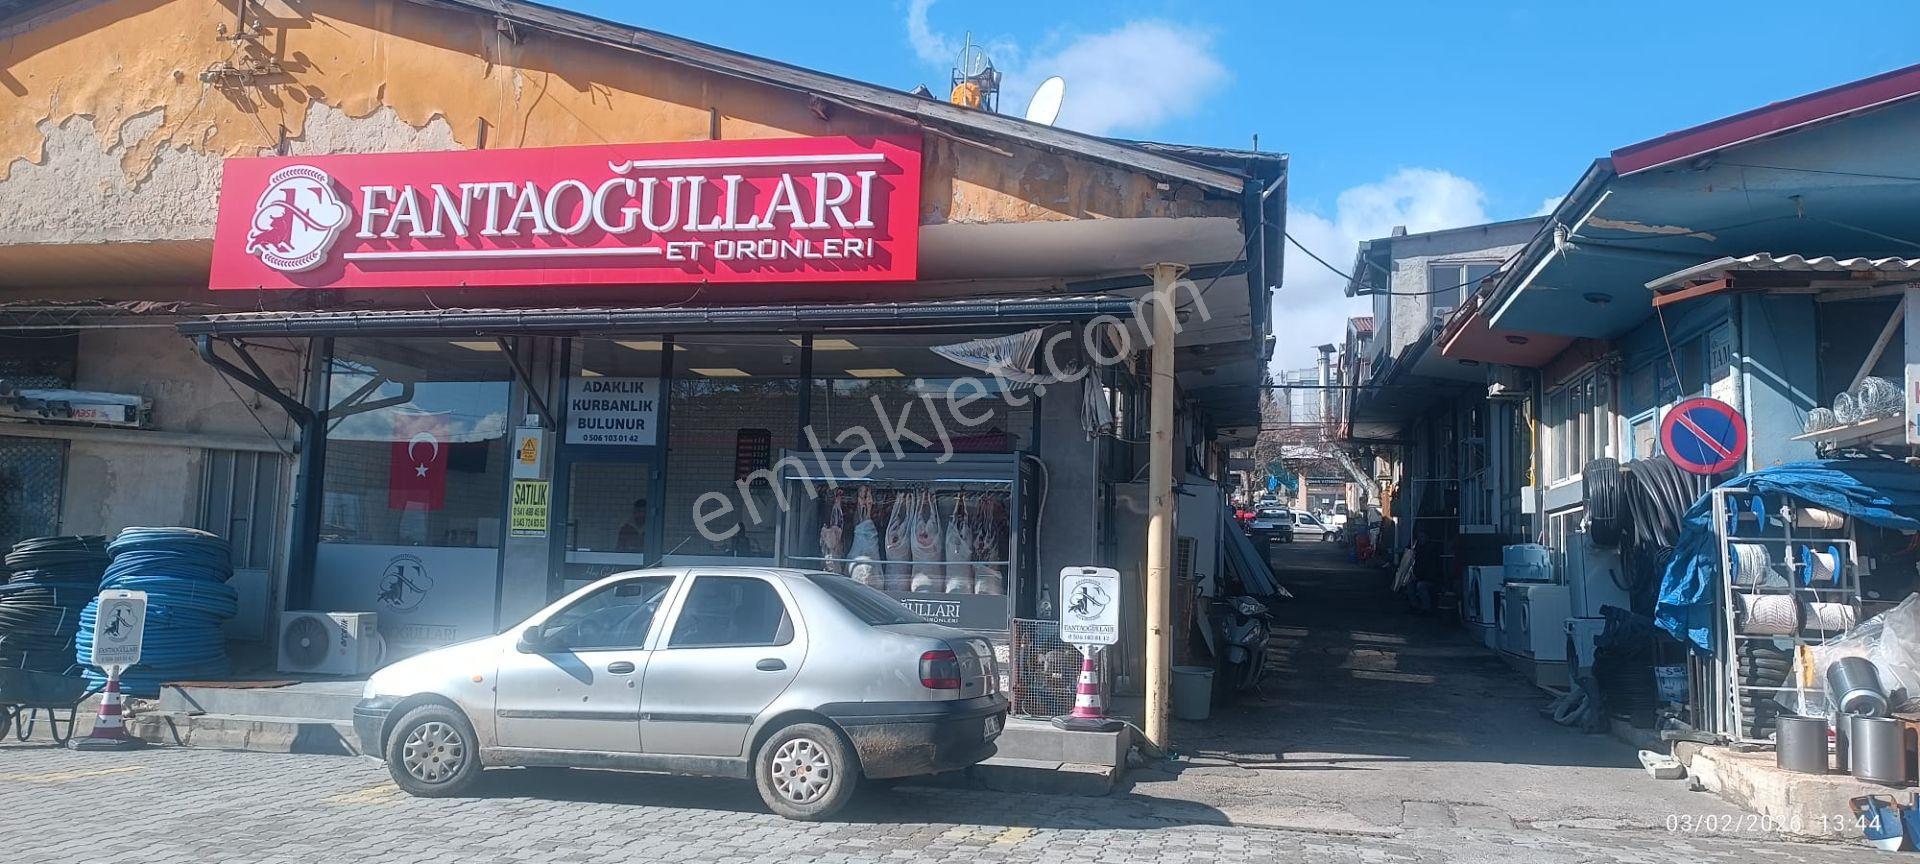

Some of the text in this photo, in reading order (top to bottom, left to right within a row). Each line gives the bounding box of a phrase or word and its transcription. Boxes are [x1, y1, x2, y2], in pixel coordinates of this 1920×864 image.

[356, 160, 877, 239] FANTAOĞULLARI
[666, 241, 706, 261] ET
[582, 381, 644, 394] ADAKLIK
[572, 399, 653, 412] KURBANLIK
[577, 418, 645, 430] BULUNUR
[583, 434, 589, 442] 0
[514, 483, 548, 506] SATILIK
